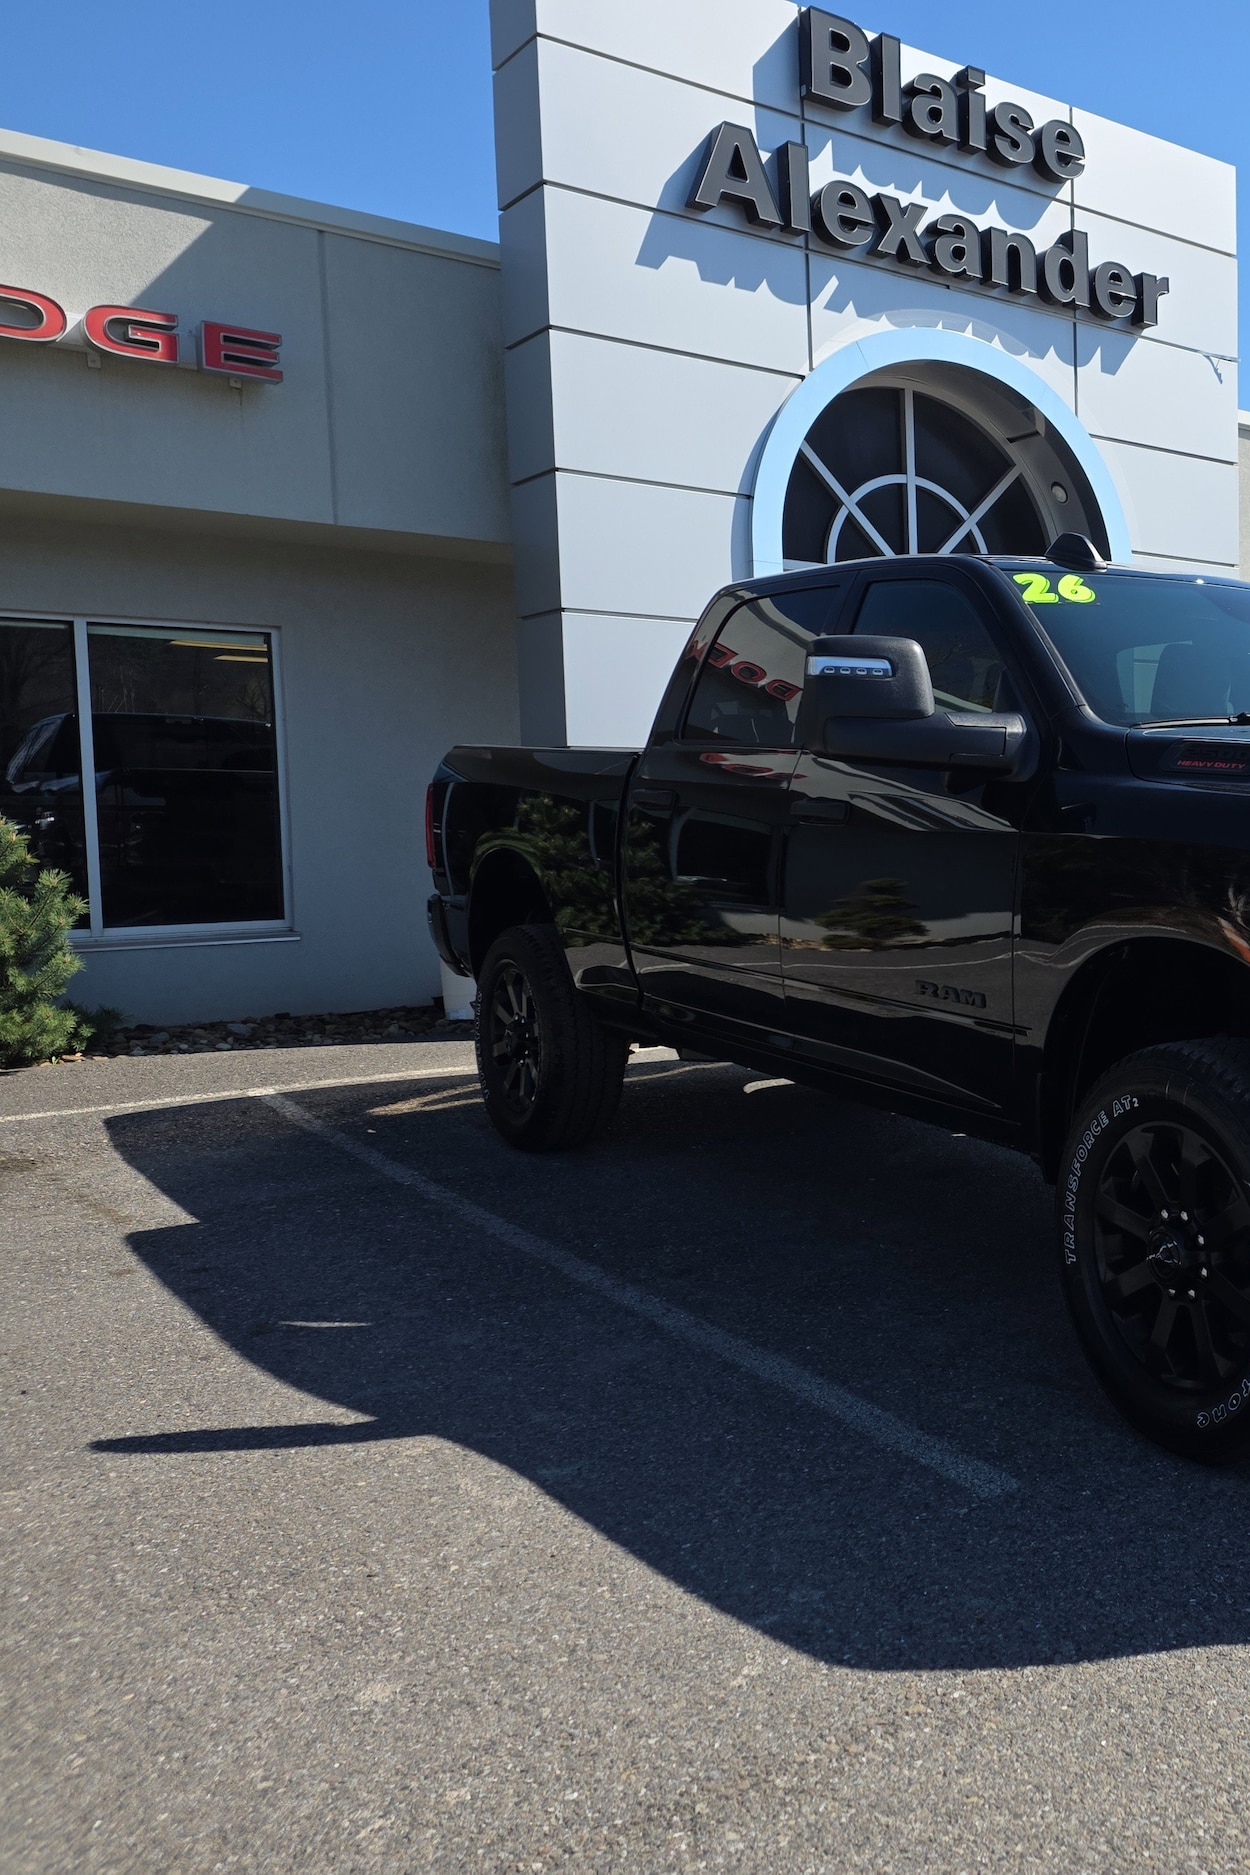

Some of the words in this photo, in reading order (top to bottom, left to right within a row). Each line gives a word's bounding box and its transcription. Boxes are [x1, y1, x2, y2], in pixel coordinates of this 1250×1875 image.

[801, 5, 1086, 183] Blaise
[685, 121, 1170, 329] Alexander
[1012, 573, 1096, 603] 26
[1177, 760, 1214, 768] HEAVY
[1214, 761, 1246, 769] DUTY
[915, 979, 987, 1008] RAM
[1063, 1110, 1110, 1265] TRANSFORCE
